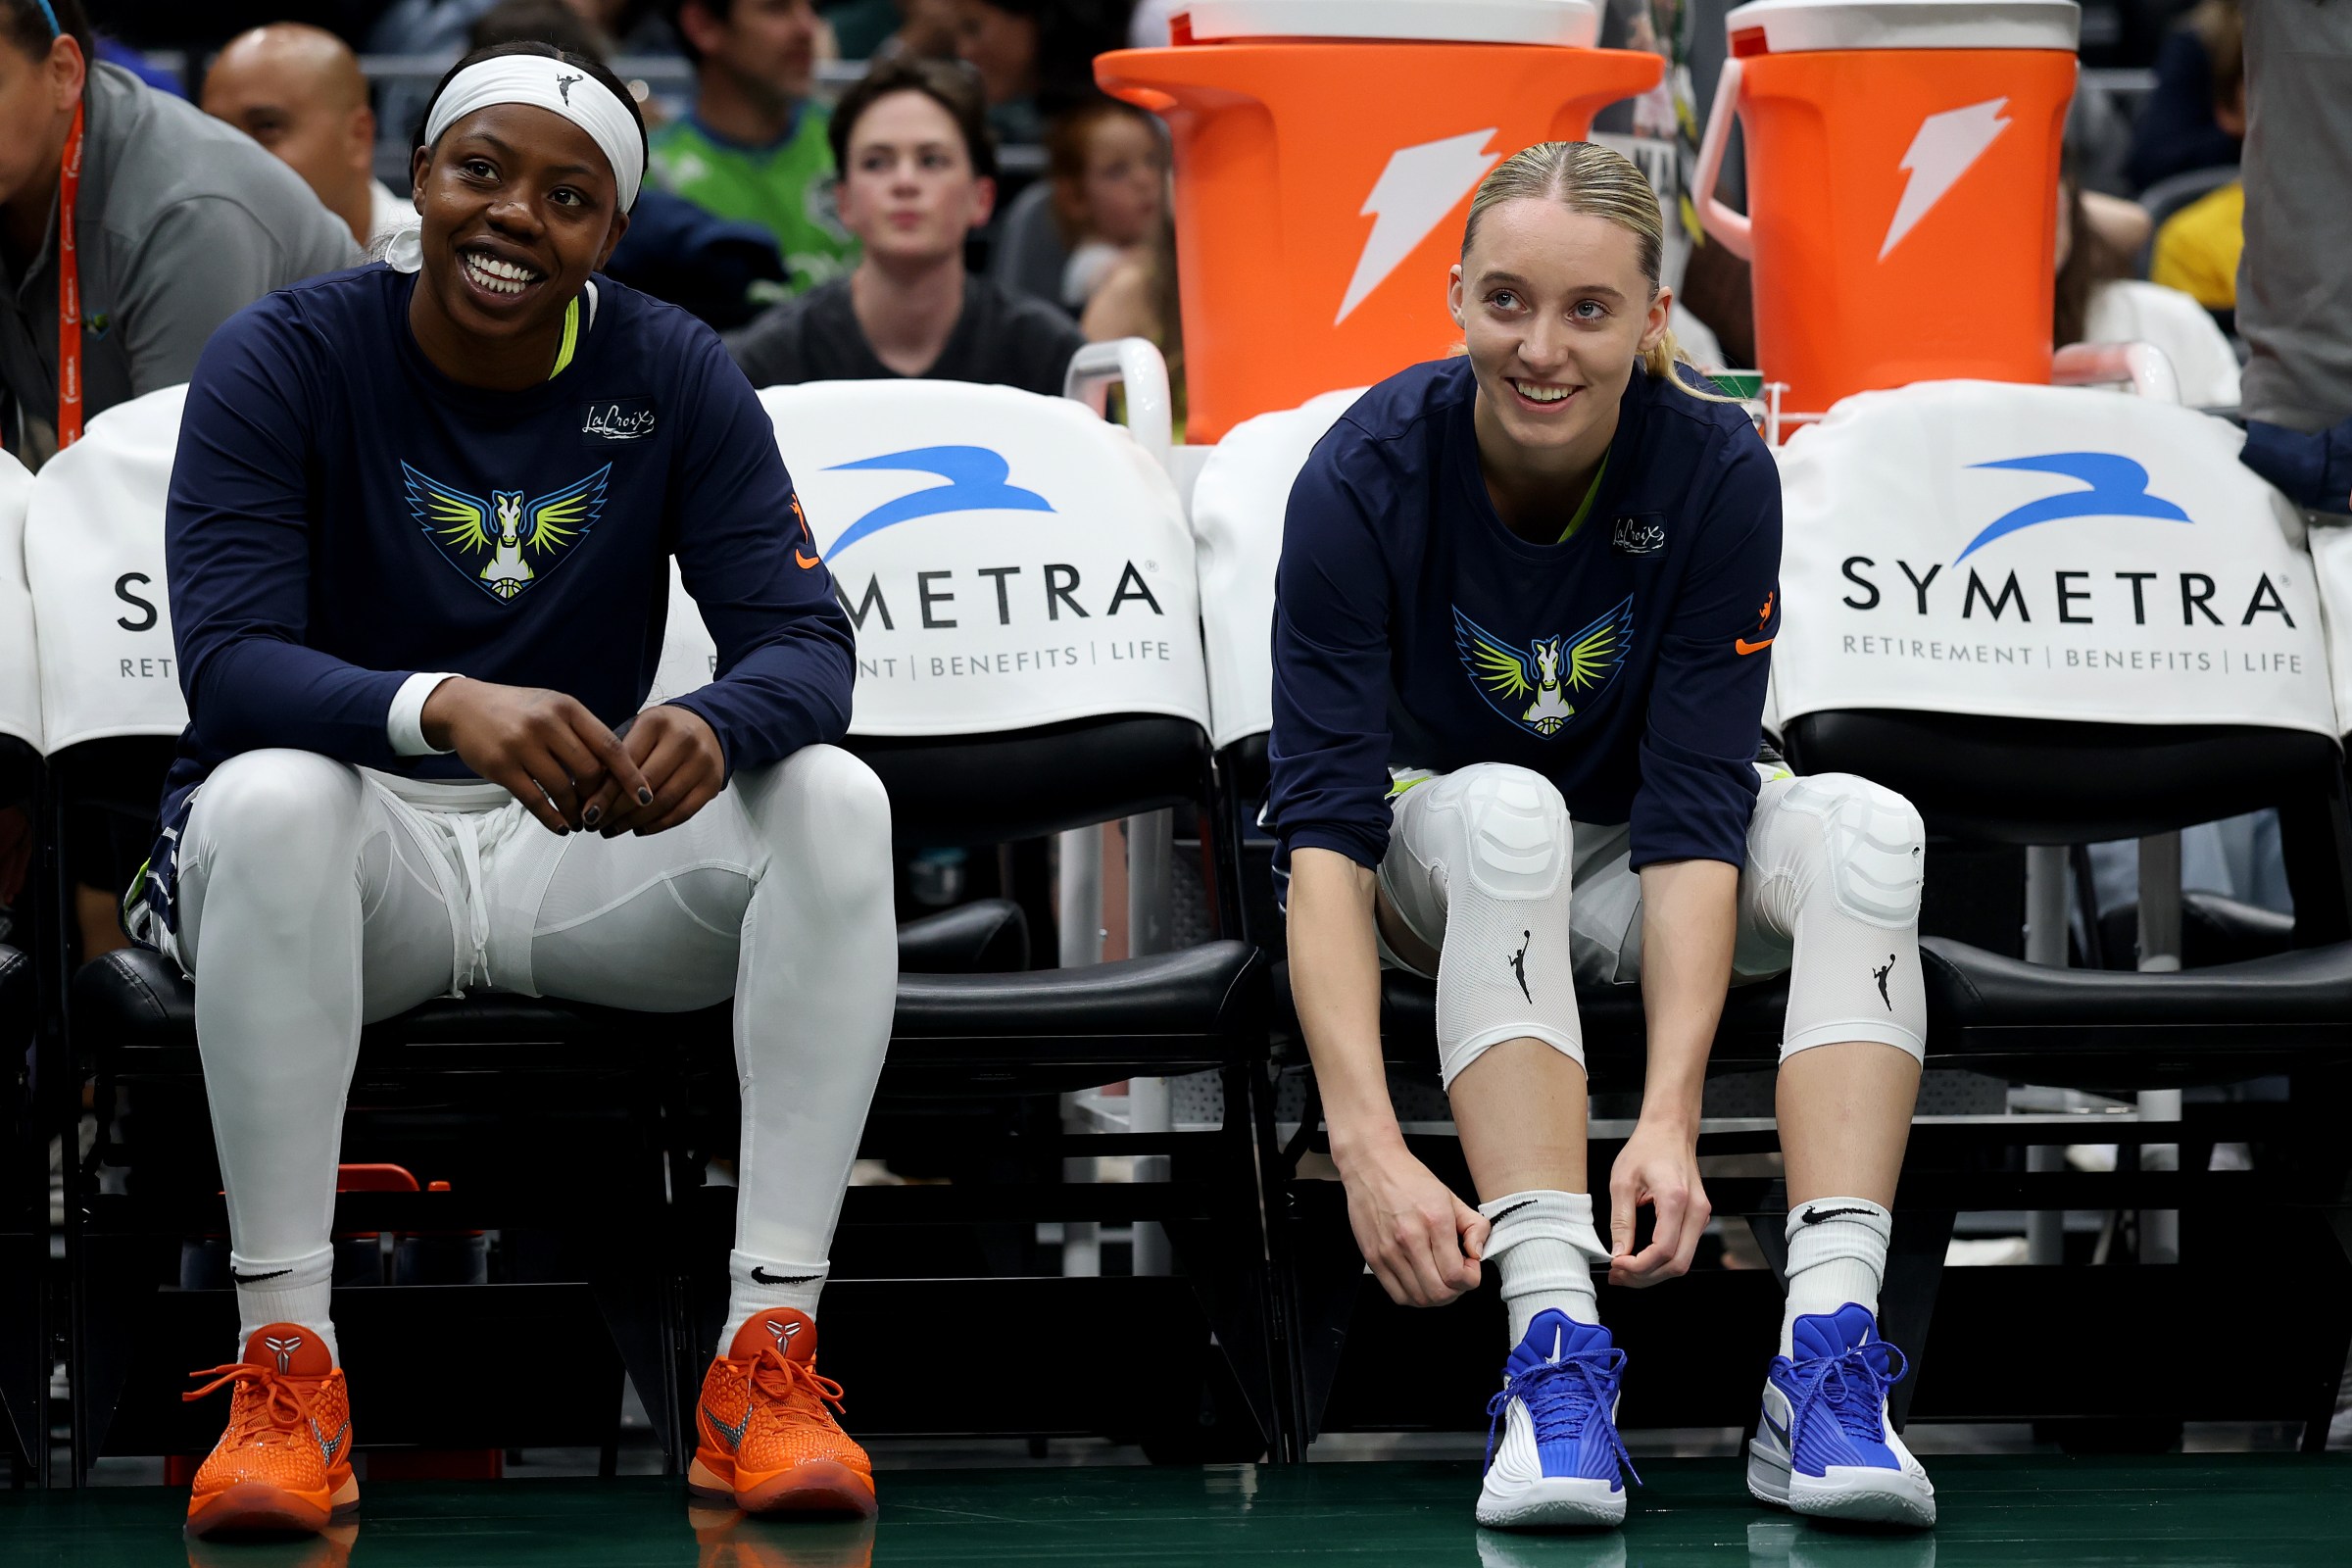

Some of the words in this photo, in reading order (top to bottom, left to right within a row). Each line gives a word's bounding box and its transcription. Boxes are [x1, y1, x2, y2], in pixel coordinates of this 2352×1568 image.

[832, 560, 1165, 632] METRA
[1841, 556, 2297, 630] SYMETRA
[930, 646, 1078, 677] BENEFITS
[1111, 641, 1170, 661] LIFE
[1842, 635, 2032, 665] RETIREMENT
[2065, 649, 2211, 670] BENEFITS
[2244, 653, 2302, 674] LIFE
